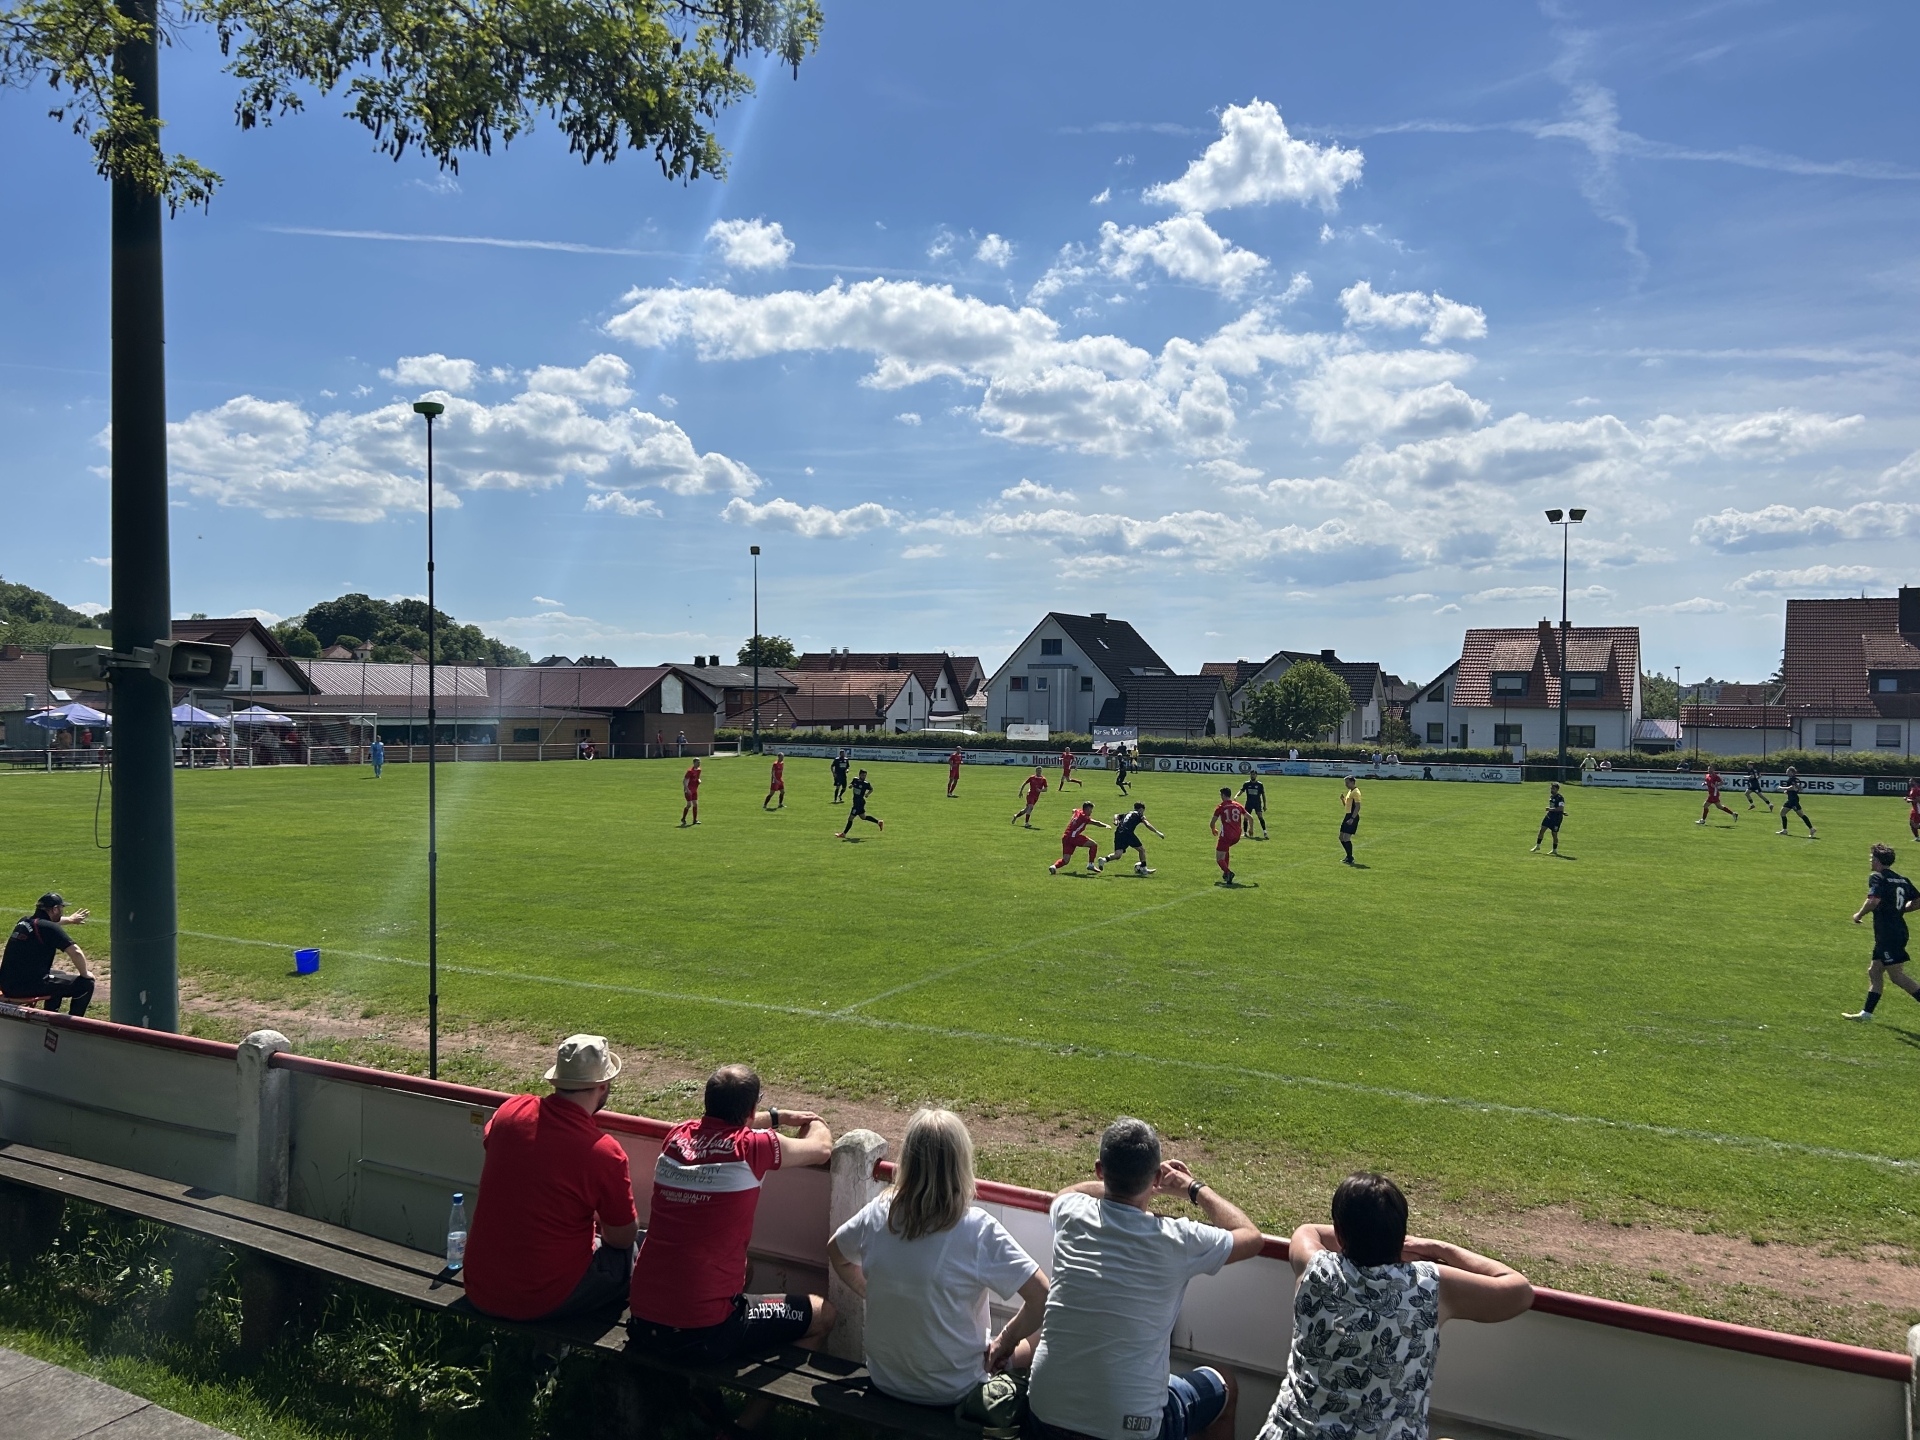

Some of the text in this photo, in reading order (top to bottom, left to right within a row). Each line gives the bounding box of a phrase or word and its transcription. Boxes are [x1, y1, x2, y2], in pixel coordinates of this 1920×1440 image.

[1176, 760, 1235, 773] ERDINGER
[1732, 779, 1835, 790] KRH EDERS
[1224, 808, 1240, 823] 18
[1895, 886, 1905, 911] 6
[701, 1166, 721, 1175] CITY
[683, 1192, 712, 1202] QUALITY
